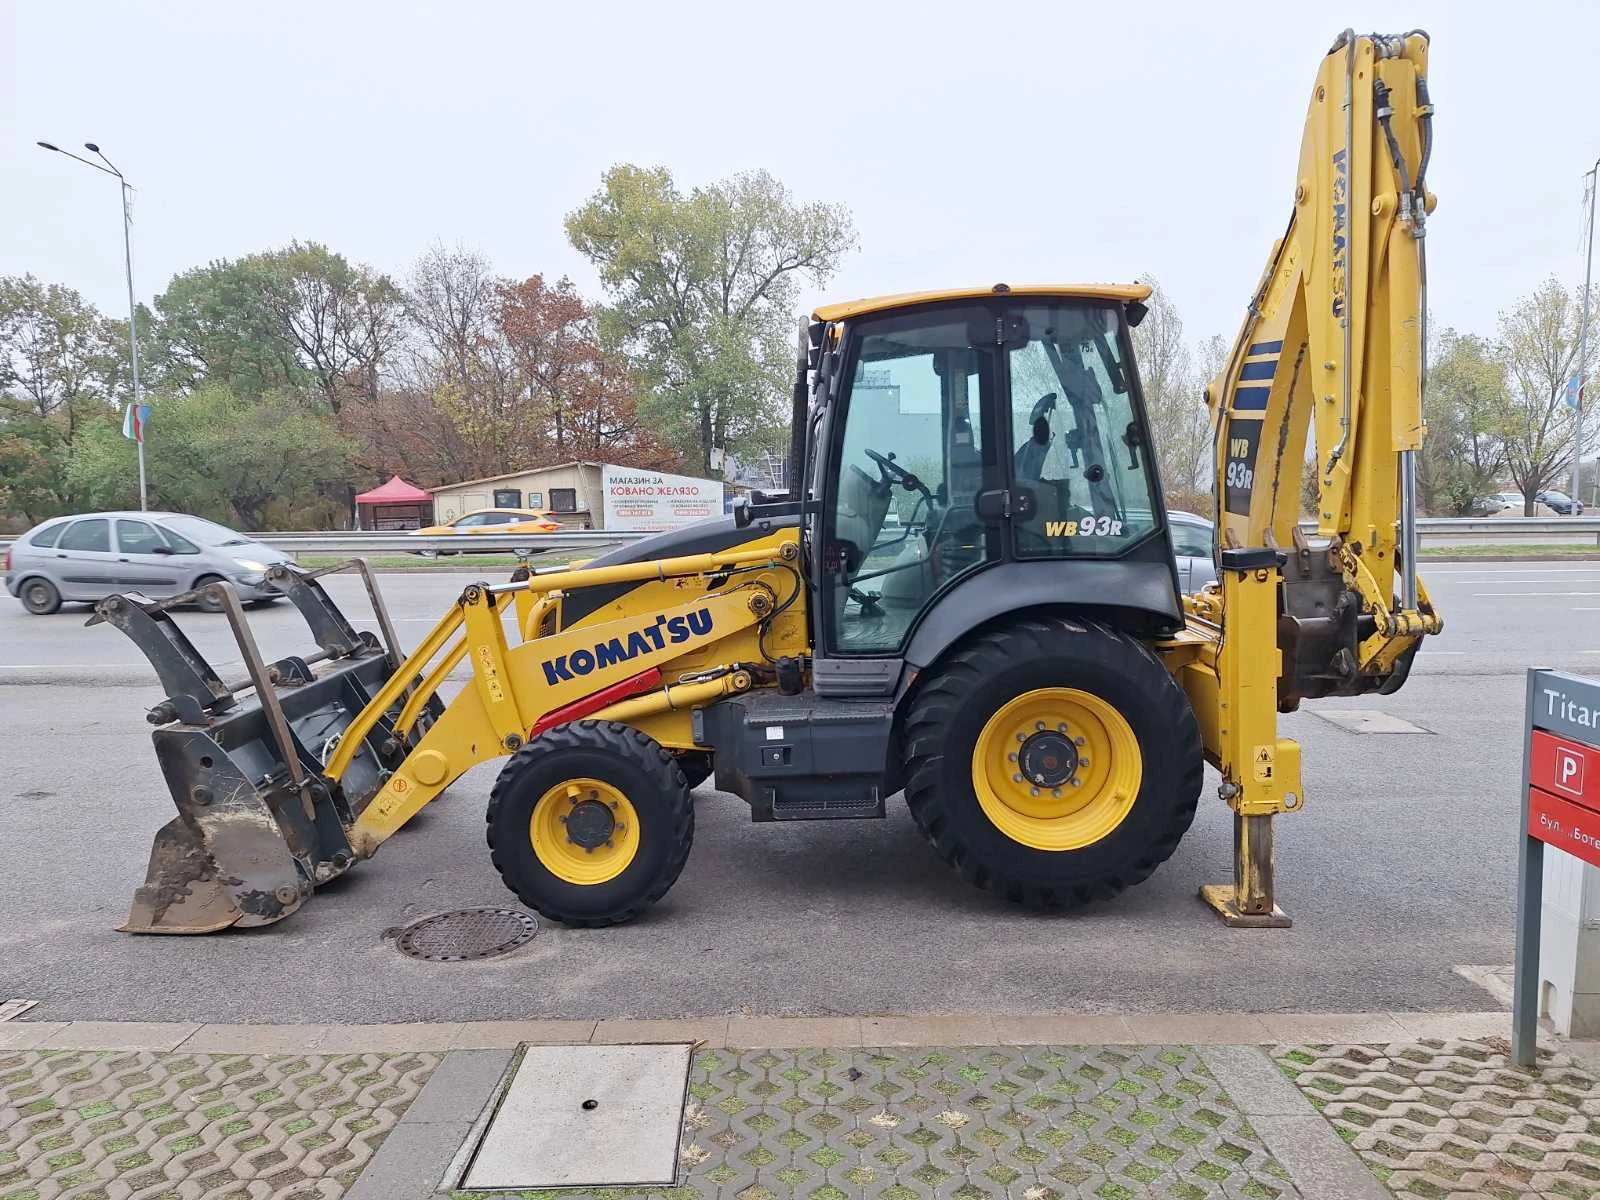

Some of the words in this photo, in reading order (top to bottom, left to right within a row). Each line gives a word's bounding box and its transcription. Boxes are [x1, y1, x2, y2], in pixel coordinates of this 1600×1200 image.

[1231, 438, 1249, 458] WB
[609, 477, 651, 485] МАГАЗИН
[652, 477, 664, 485] ЗА
[1226, 461, 1253, 489] 93R
[610, 487, 655, 496] КОВАНО
[657, 487, 699, 496] ЖЕЛЯЗО
[541, 608, 713, 686] KOMATSU
[1562, 756, 1577, 784] P
